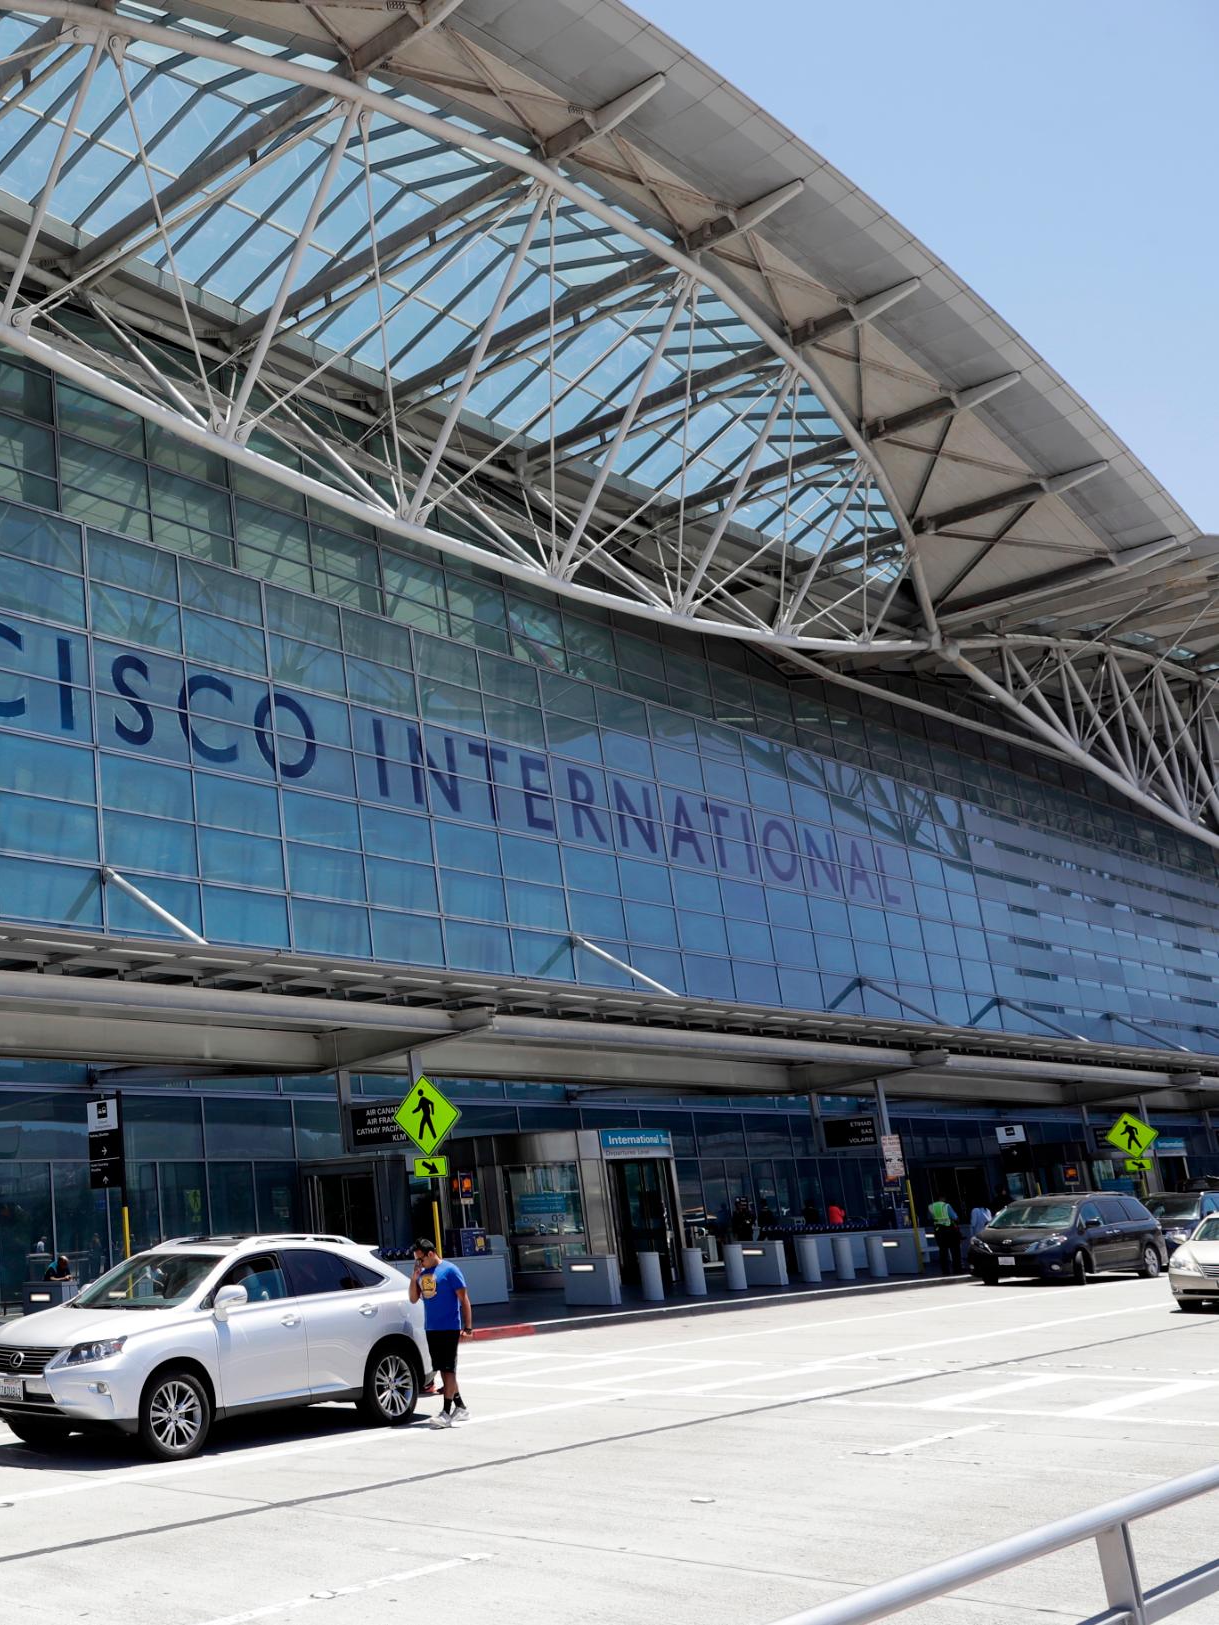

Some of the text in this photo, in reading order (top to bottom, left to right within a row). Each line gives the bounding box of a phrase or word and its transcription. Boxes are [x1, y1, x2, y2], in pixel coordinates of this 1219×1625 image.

[372, 718, 902, 906] INTERNATIONAL
[366, 1109, 377, 1117] AIR
[356, 1127, 380, 1136] CATHAY
[392, 1133, 407, 1141] KLM
[608, 1134, 660, 1145] International
[551, 1214, 565, 1223] 03
